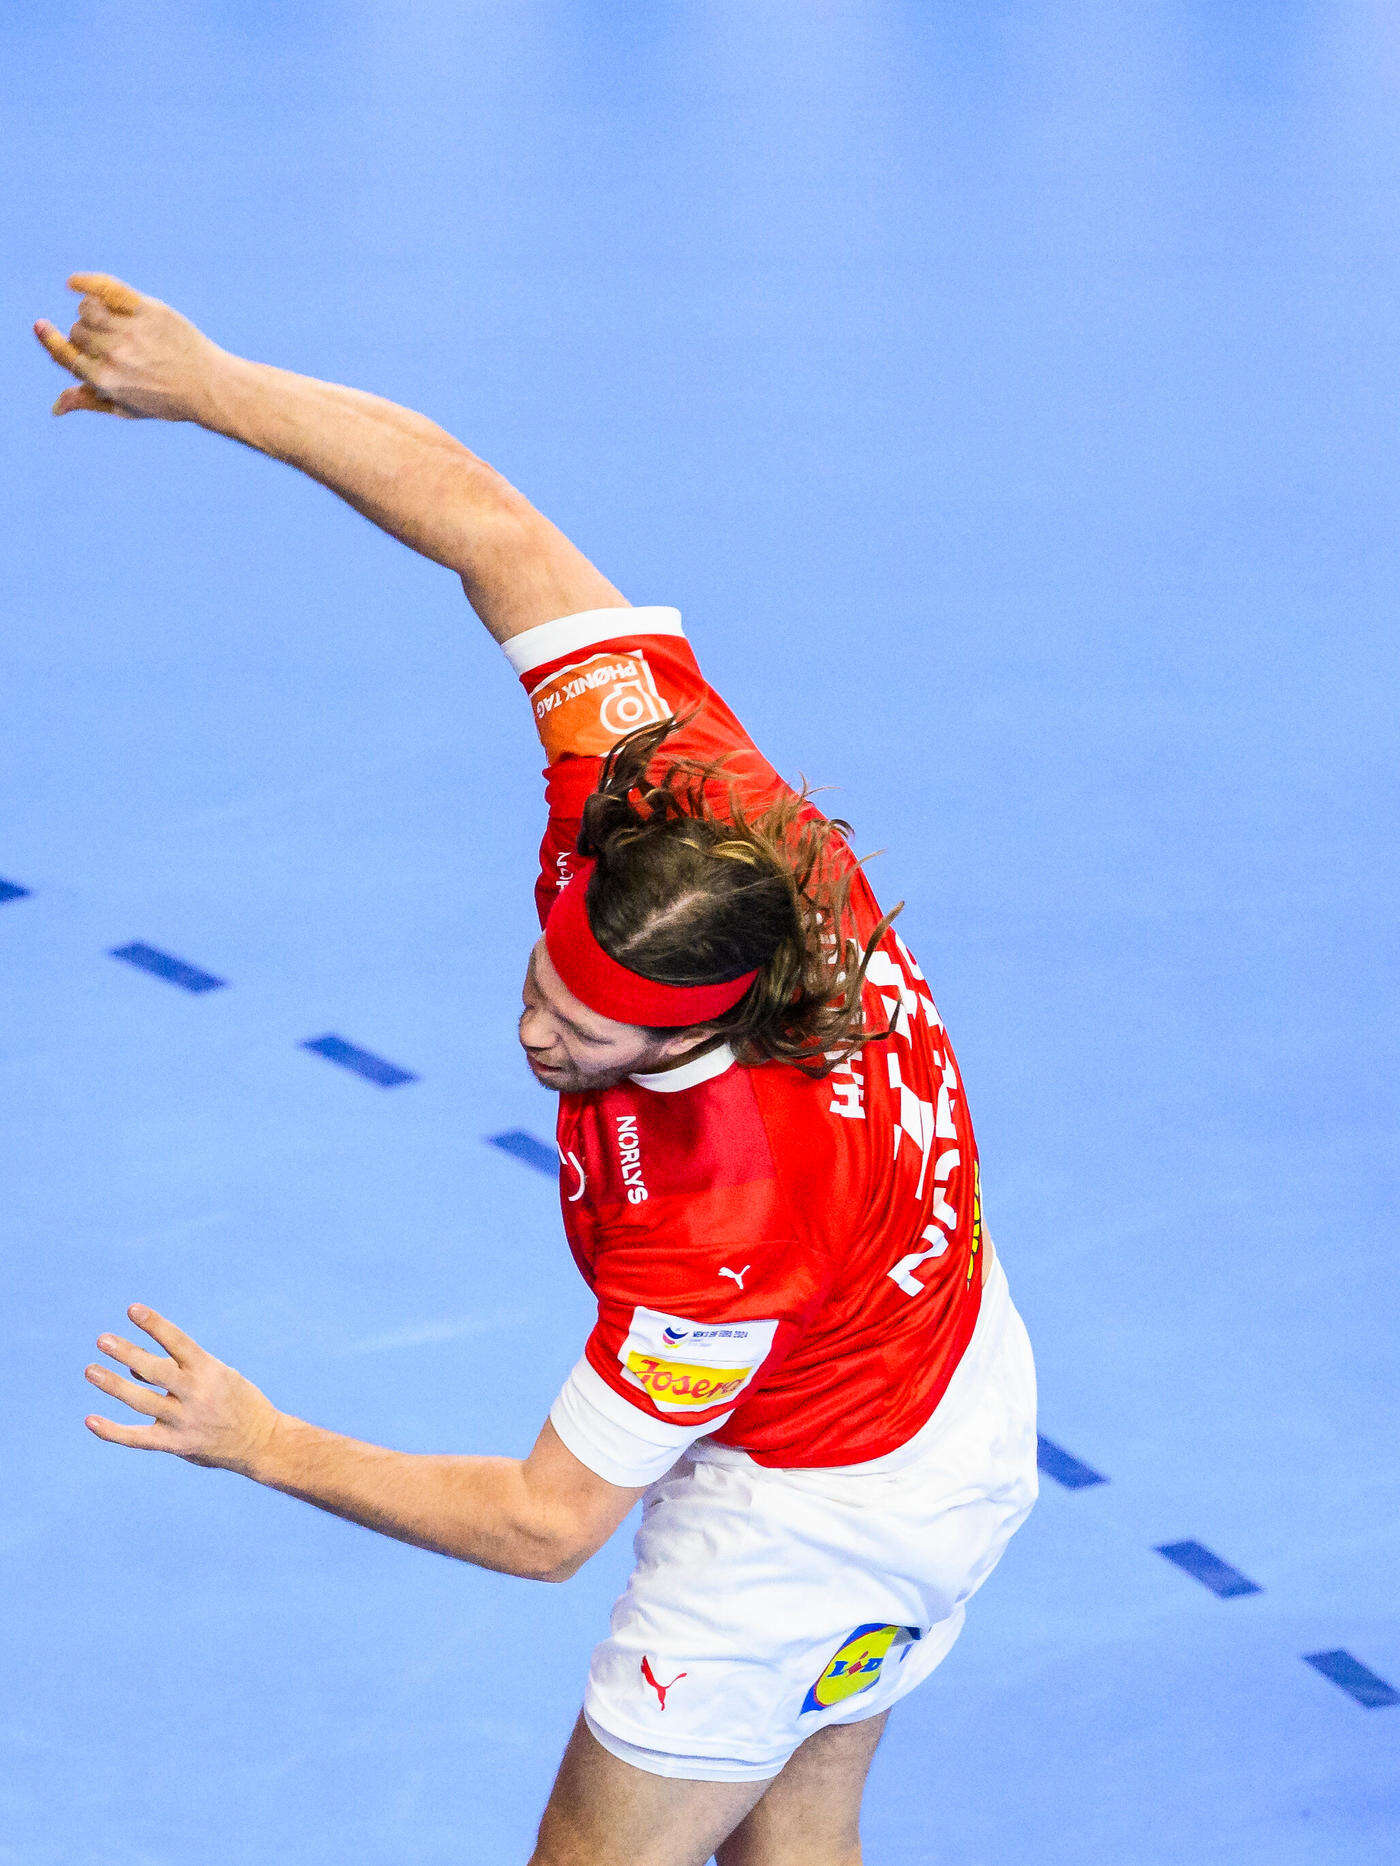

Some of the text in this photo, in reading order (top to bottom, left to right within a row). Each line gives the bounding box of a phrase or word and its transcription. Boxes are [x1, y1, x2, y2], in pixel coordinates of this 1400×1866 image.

[536, 660, 638, 719] PHØNIX TAG
[616, 1116, 648, 1204] NORLYS
